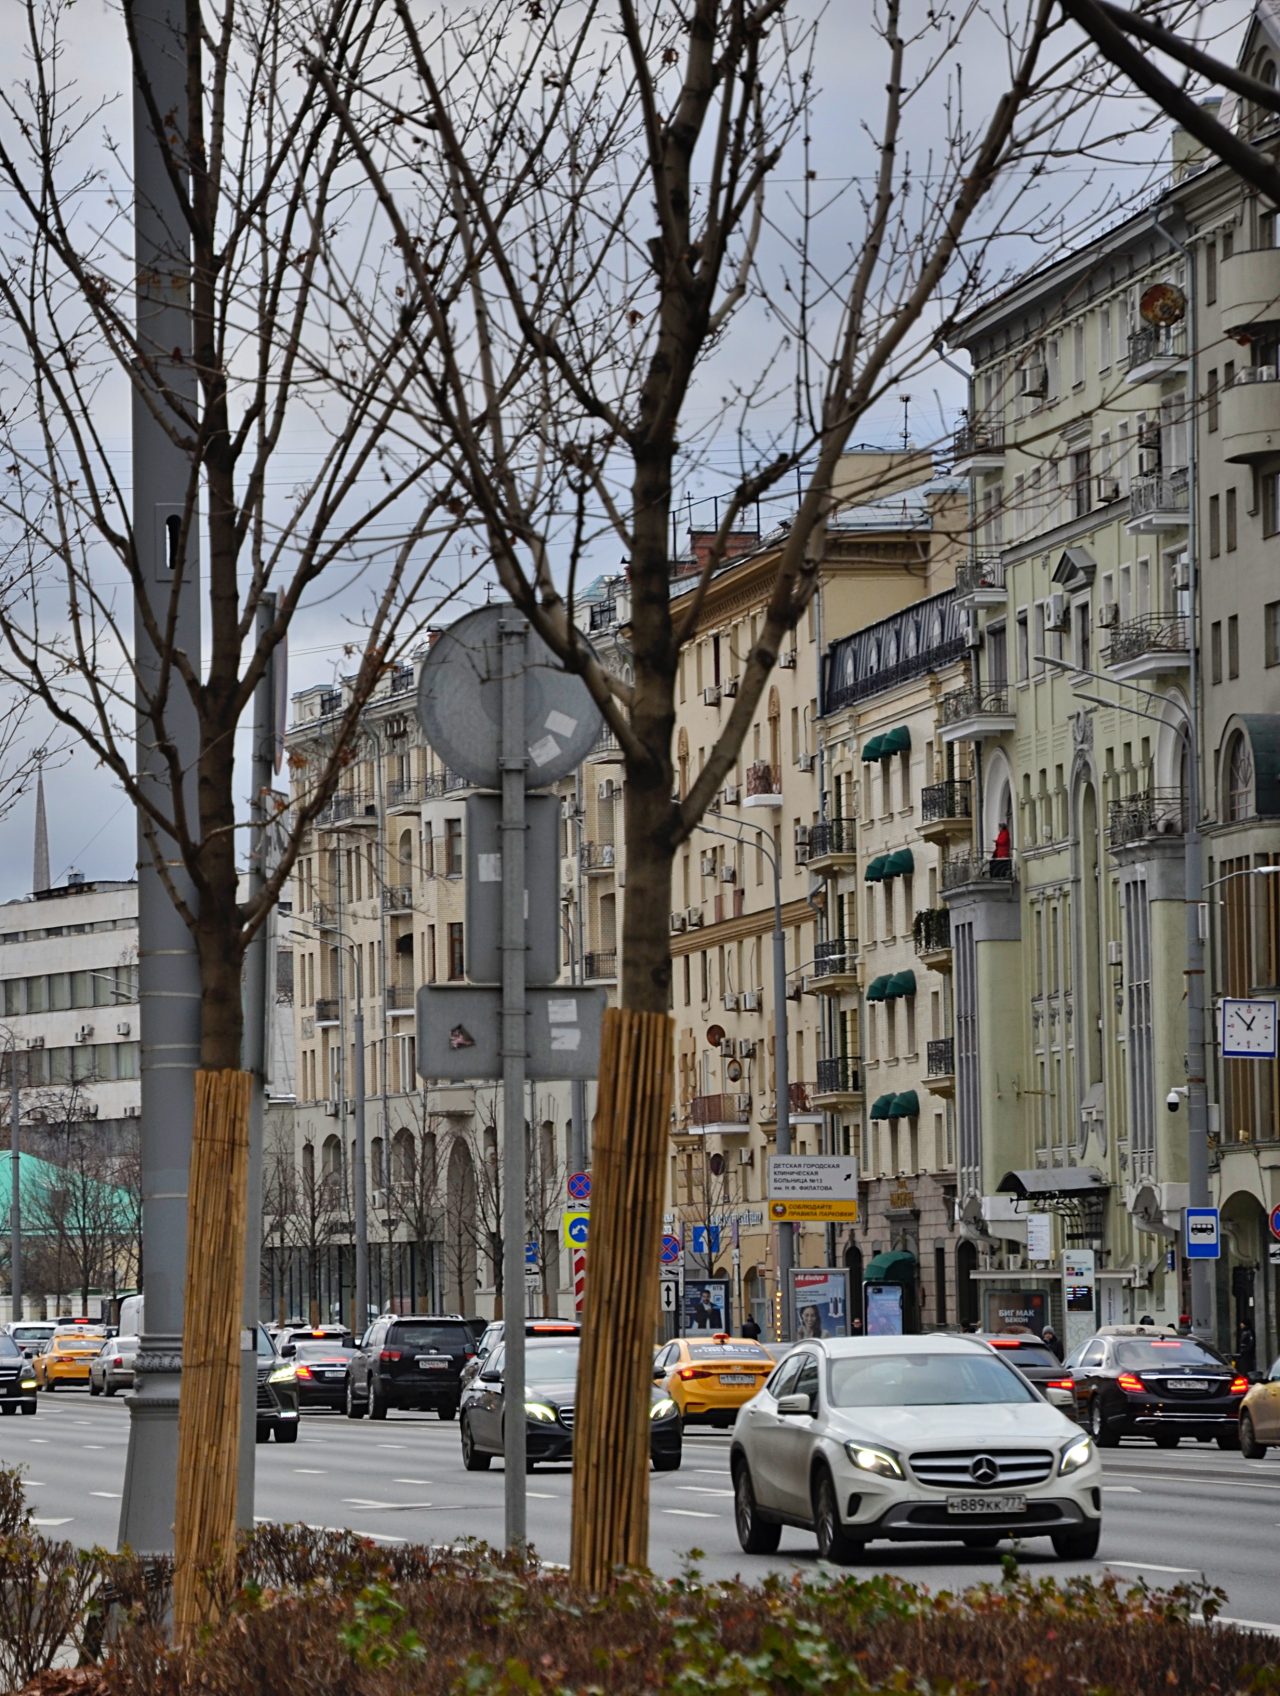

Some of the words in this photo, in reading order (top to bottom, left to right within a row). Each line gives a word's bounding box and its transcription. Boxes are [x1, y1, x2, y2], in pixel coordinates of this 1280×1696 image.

[999, 1309, 1016, 1317] БИГ
[1016, 1309, 1034, 1317] МАК
[1002, 1496, 1022, 1508] 777
